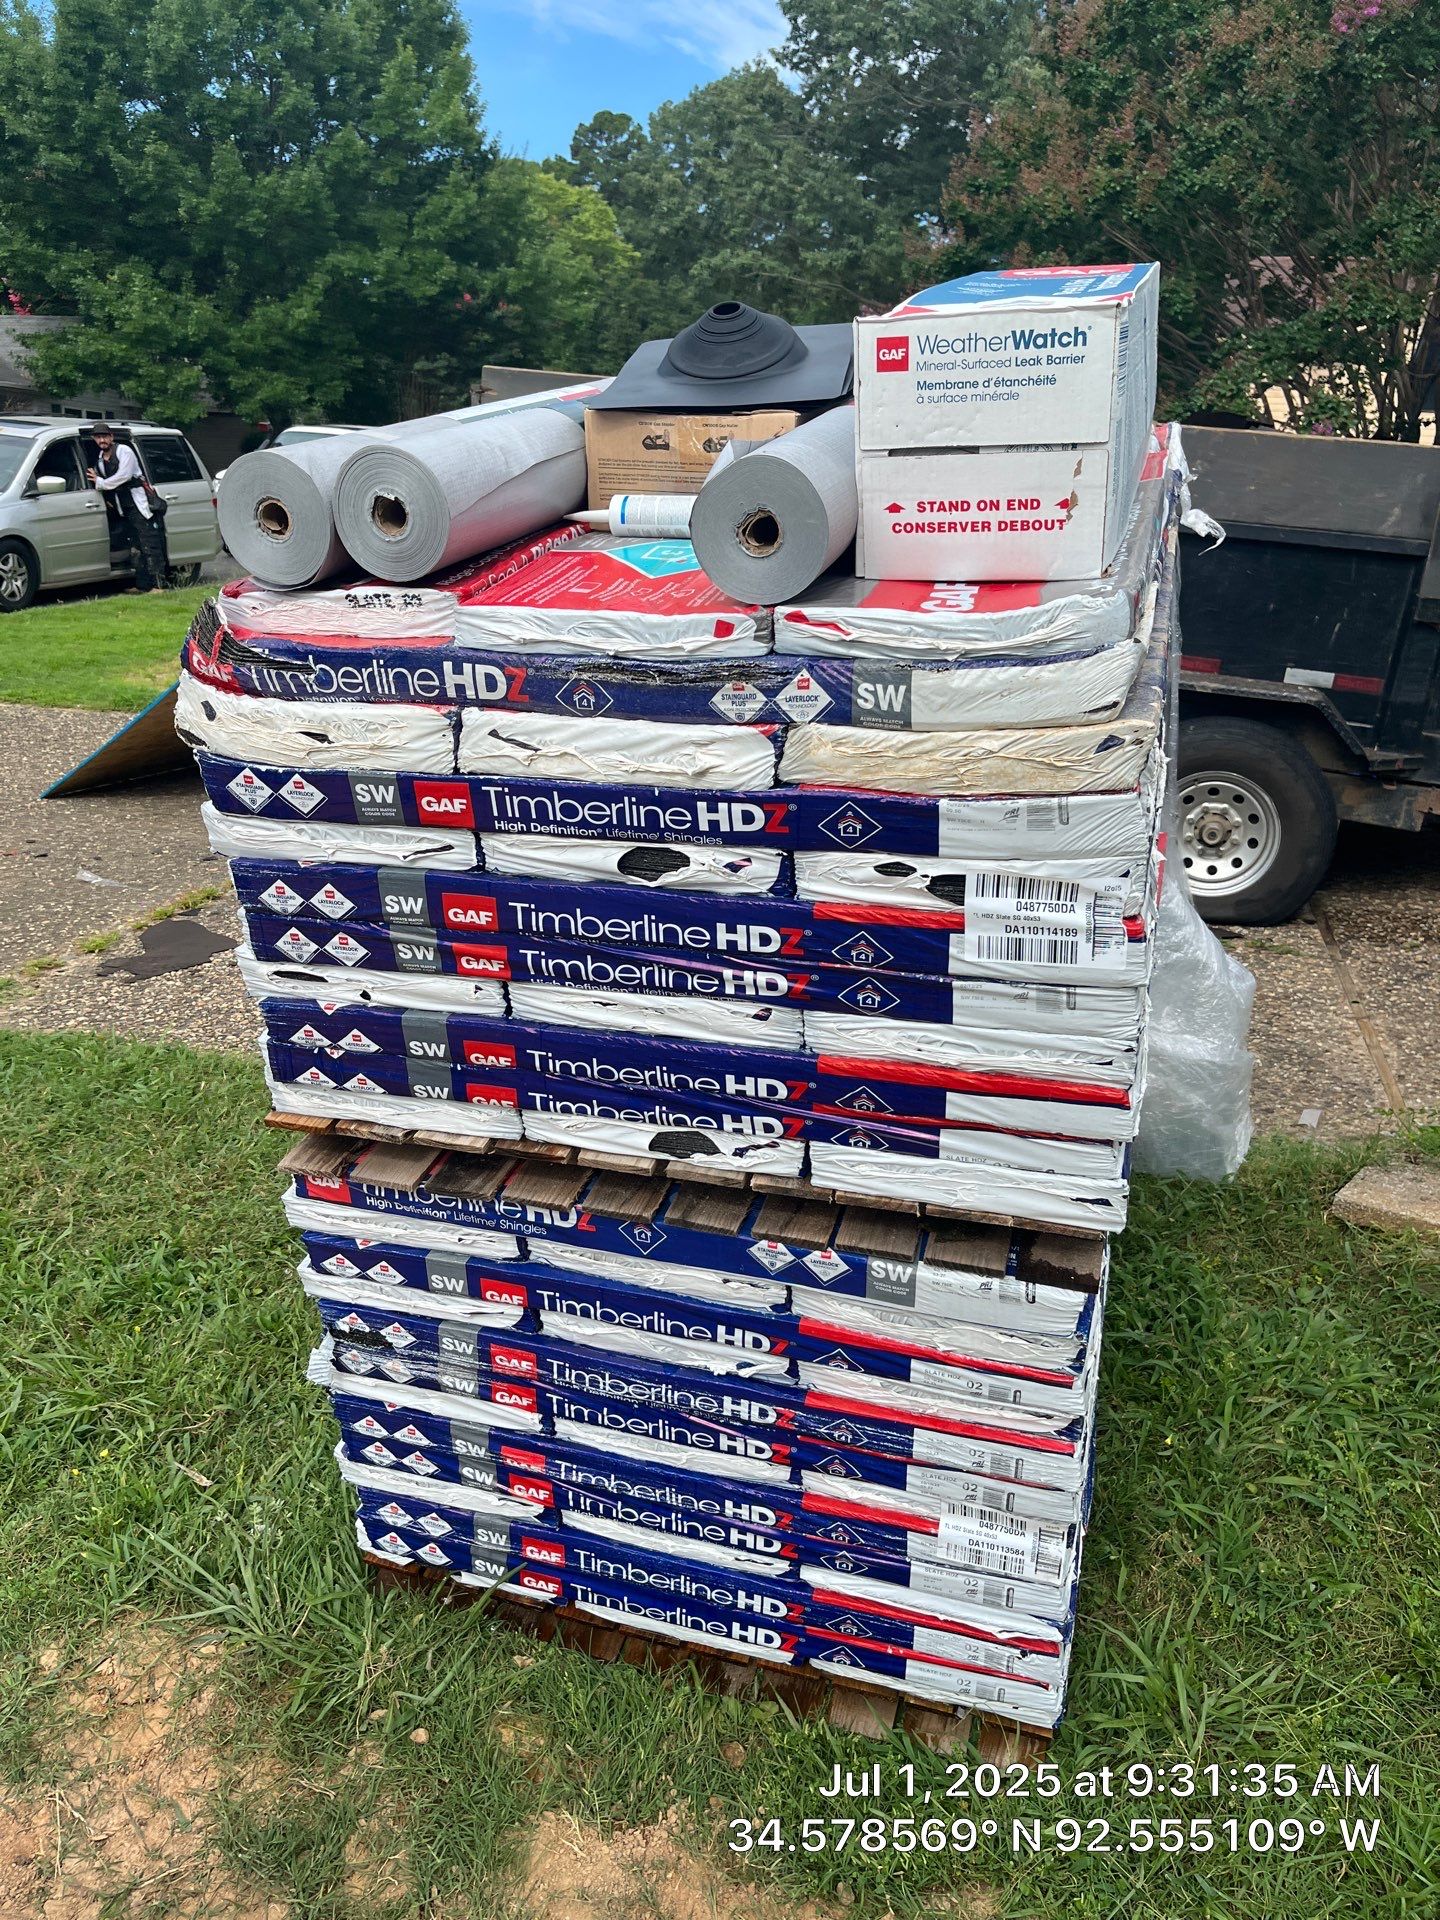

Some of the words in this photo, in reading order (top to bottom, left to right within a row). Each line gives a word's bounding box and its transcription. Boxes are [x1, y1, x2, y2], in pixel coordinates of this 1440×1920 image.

[879, 348, 906, 361] GAF
[916, 357, 1012, 372] Mineral-Surfaced
[1015, 354, 1042, 368] Leak
[1046, 353, 1085, 366] Barrier
[916, 378, 979, 391] Membrane
[982, 375, 1057, 389] d'étanchéité
[916, 392, 924, 405] à
[926, 391, 968, 404] surface
[970, 388, 1019, 402] minérale
[916, 500, 971, 513] STAND
[976, 499, 1000, 512] ON
[1007, 498, 1041, 511] END
[891, 521, 992, 534] CONSERVER
[998, 519, 1067, 532] DEBOUT
[721, 692, 757, 701] STAINGUARD
[785, 695, 819, 703] LAYERLOCK
[856, 682, 907, 713] SW
[354, 783, 394, 804] SW
[421, 796, 467, 814] GAF
[481, 786, 692, 830] Timberline
[494, 820, 526, 834] High
[664, 832, 723, 846] Shingles
[384, 894, 423, 915] SW
[1016, 900, 1076, 914] 0487750DA
[448, 908, 493, 925] GAF
[508, 901, 710, 948] Timberline
[1004, 925, 1078, 937] DA110114189
[396, 943, 434, 961] SW
[460, 956, 505, 973] GAF
[519, 950, 719, 994] Timberline
[409, 1040, 446, 1058] SW
[469, 1053, 512, 1067] GAF
[526, 1050, 720, 1091] Timberline
[413, 1084, 449, 1100] SW
[472, 1096, 514, 1108] GAF
[528, 1092, 717, 1130] Timberline
[366, 1196, 392, 1210] High
[499, 1219, 547, 1235] Shingles
[871, 1260, 913, 1283] SW
[431, 1275, 464, 1293] SW
[485, 1290, 524, 1306] GAF
[536, 1289, 712, 1341] Timberline
[441, 1337, 475, 1355] SW
[494, 1355, 532, 1372] GAF
[440, 1376, 475, 1394] SW
[546, 1358, 718, 1413] Timberline
[966, 1380, 983, 1391] 02
[495, 1391, 533, 1406] GAF
[546, 1393, 715, 1448] Timberline
[454, 1439, 486, 1458] SW
[968, 1449, 985, 1459] 02
[462, 1466, 494, 1485] SW
[513, 1484, 549, 1501] GAF
[555, 1459, 721, 1514] Timberline
[962, 1483, 978, 1493] 02
[562, 1487, 726, 1541] Timberline
[477, 1528, 508, 1546] SW
[979, 1520, 1026, 1538] 0487750DA
[525, 1546, 562, 1563] GAF
[968, 1538, 1025, 1557] DA110113584
[474, 1559, 505, 1576] SW
[522, 1576, 559, 1593] GAF
[573, 1548, 733, 1606] Timberline
[963, 1578, 979, 1588] 02
[570, 1583, 728, 1636] Timberline
[964, 1643, 979, 1653] 02
[956, 1678, 971, 1687] 02
